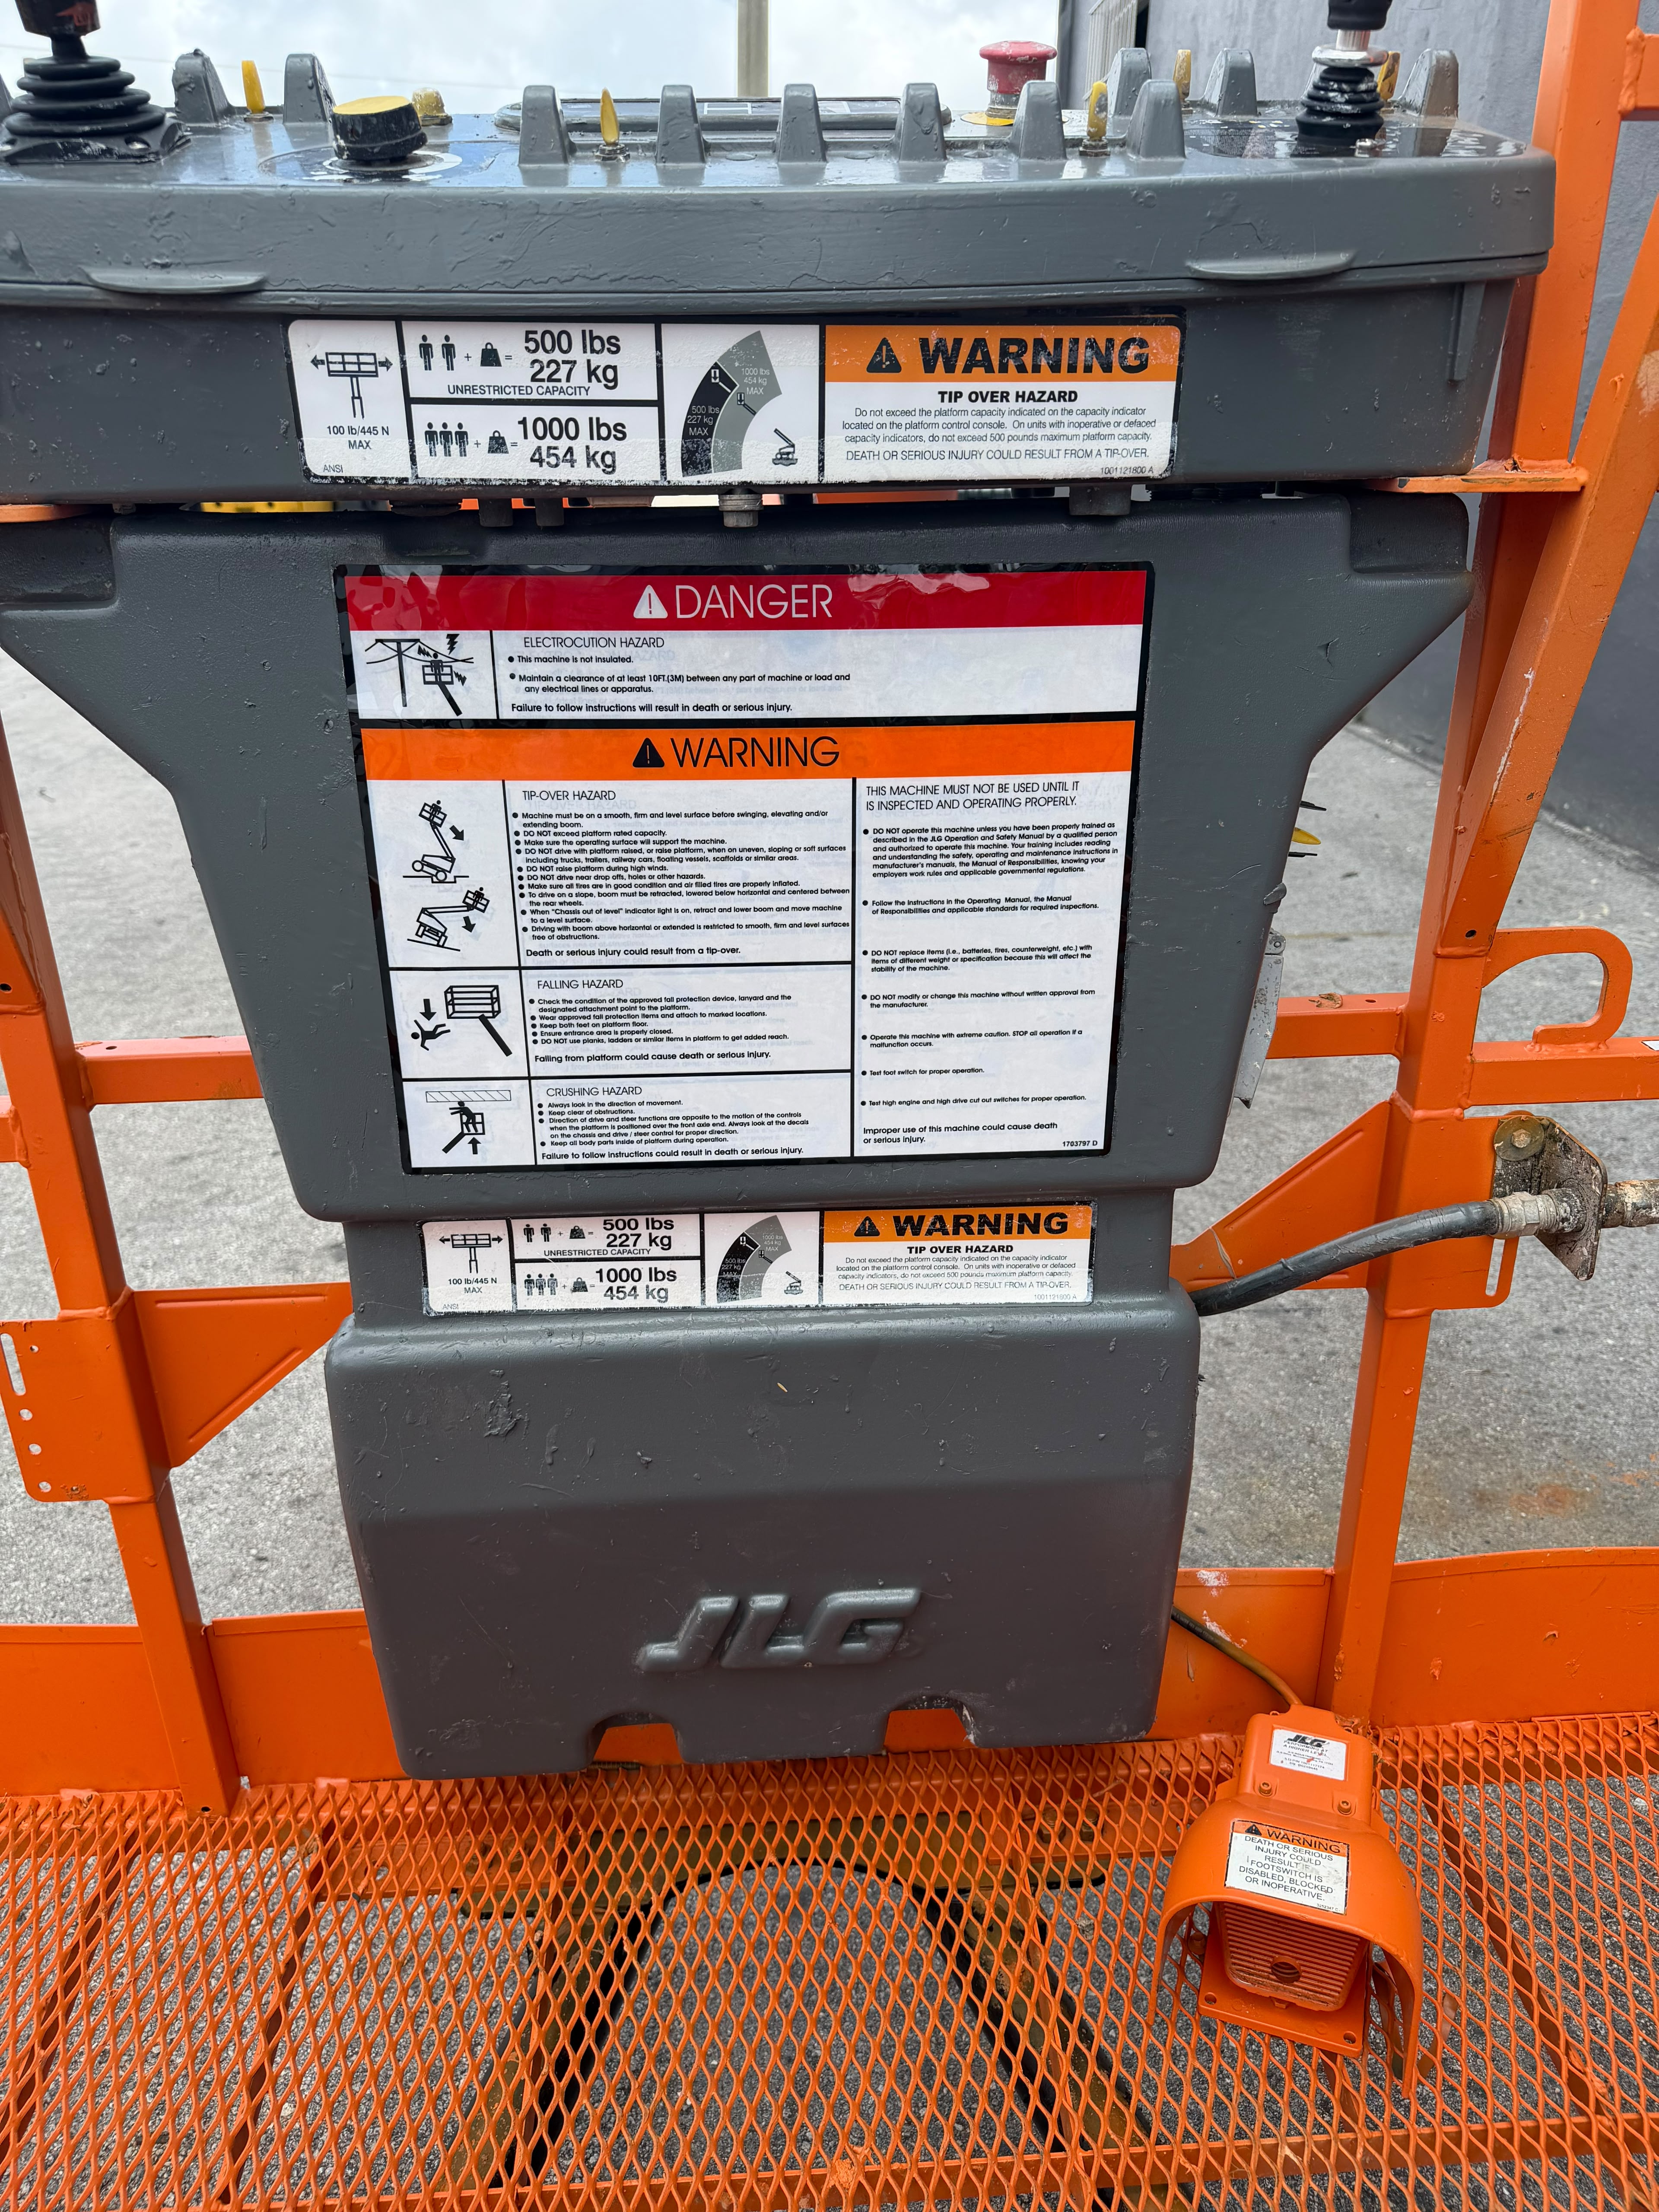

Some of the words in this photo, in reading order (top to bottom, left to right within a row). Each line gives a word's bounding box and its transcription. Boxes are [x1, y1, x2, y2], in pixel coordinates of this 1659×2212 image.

[524, 329, 572, 354] 500
[581, 329, 620, 354] lbs
[918, 337, 1149, 373] WARNING
[530, 360, 576, 383] 227
[588, 359, 619, 390] kg
[758, 376, 766, 385] kg
[448, 385, 533, 395] UNRESTRICTED
[536, 385, 590, 395] CAPACITY
[938, 391, 963, 403] TIP
[968, 391, 1010, 402] OVER
[1015, 391, 1077, 402] HAZARD
[855, 407, 867, 416] Do
[870, 408, 883, 416] not
[886, 407, 915, 416] exceed
[919, 407, 931, 416] the
[934, 407, 968, 418] platform
[971, 407, 1005, 418] capacity
[1008, 407, 1045, 416] indicated
[1061, 407, 1073, 415] the
[1075, 407, 1109, 417] capacity
[1112, 407, 1146, 415] indicator
[704, 415, 713, 425] kg
[327, 426, 344, 435] 100
[347, 426, 378, 435] lb/445
[381, 426, 389, 435] N
[518, 416, 579, 441] 1000
[588, 417, 626, 441] lbs
[348, 440, 371, 449] MAX
[530, 445, 577, 468] 454
[585, 445, 616, 475] kg
[846, 450, 880, 460] DEATH
[883, 450, 898, 460] OR
[901, 450, 945, 460] SERIOUS
[948, 450, 984, 460] INJURY
[986, 449, 1021, 459] COULD
[1024, 449, 1062, 459] RESULT
[1064, 448, 1093, 458] FROM
[1095, 448, 1102, 458] A
[1104, 448, 1149, 458] TIP-OVER.
[323, 464, 343, 473] ANSI
[676, 584, 832, 618] DANGER
[524, 637, 616, 647] ELECTROCUTION
[620, 637, 664, 647] HAZARD
[556, 703, 582, 712] follow
[585, 703, 636, 712] instructions
[766, 703, 792, 712] injury.
[670, 736, 839, 767] WARNING
[522, 790, 569, 800] TIP-OVER
[573, 790, 616, 800] HAZARD
[866, 786, 886, 795] THIS
[890, 785, 939, 795] MACHINE
[943, 784, 969, 794] MUST
[973, 783, 995, 793] NOT
[998, 783, 1009, 793] BE
[1013, 782, 1039, 792] USED
[1042, 782, 1068, 791] UNTIL
[1072, 781, 1079, 791] IT
[866, 801, 874, 810] IS
[878, 800, 933, 810] INSPECTED
[936, 799, 959, 809] AND
[963, 797, 1021, 808] OPERATING
[1025, 796, 1076, 807] PROPERLY.
[598, 948, 621, 957] injury
[706, 947, 740, 955] tip-over.
[537, 979, 578, 989] FALLING
[582, 979, 623, 988] HAZARD
[546, 1087, 599, 1096] CRUSHING
[602, 1086, 642, 1095] HAZARD
[603, 1218, 639, 1230] 500
[645, 1217, 674, 1230] lbs
[893, 1212, 1068, 1236] WARNING
[607, 1234, 642, 1247] 227
[648, 1234, 672, 1250] kg
[965, 1245, 1013, 1253] HAZARD
[595, 1268, 642, 1283] 1000
[648, 1267, 677, 1281] lbs
[604, 1285, 639, 1300] 454
[645, 1284, 668, 1302] kg
[636, 1587, 921, 1672] JLG
[1267, 1829, 1340, 1853] WARNING
[1245, 1836, 1274, 1847] DEATH
[1292, 1847, 1332, 1861] SERIOUS
[1255, 1845, 1287, 1857] INJURY
[1289, 1853, 1321, 1865] COULD
[1265, 1855, 1301, 1868] RESULT
[1250, 1859, 1311, 1880] FOOTSWITCH
[1239, 1866, 1286, 1883] DISABLED,
[1289, 1877, 1333, 1893] BLOCKED
[1245, 1876, 1258, 1885] OR
[1262, 1880, 1324, 1901] INOPERATIVE.
